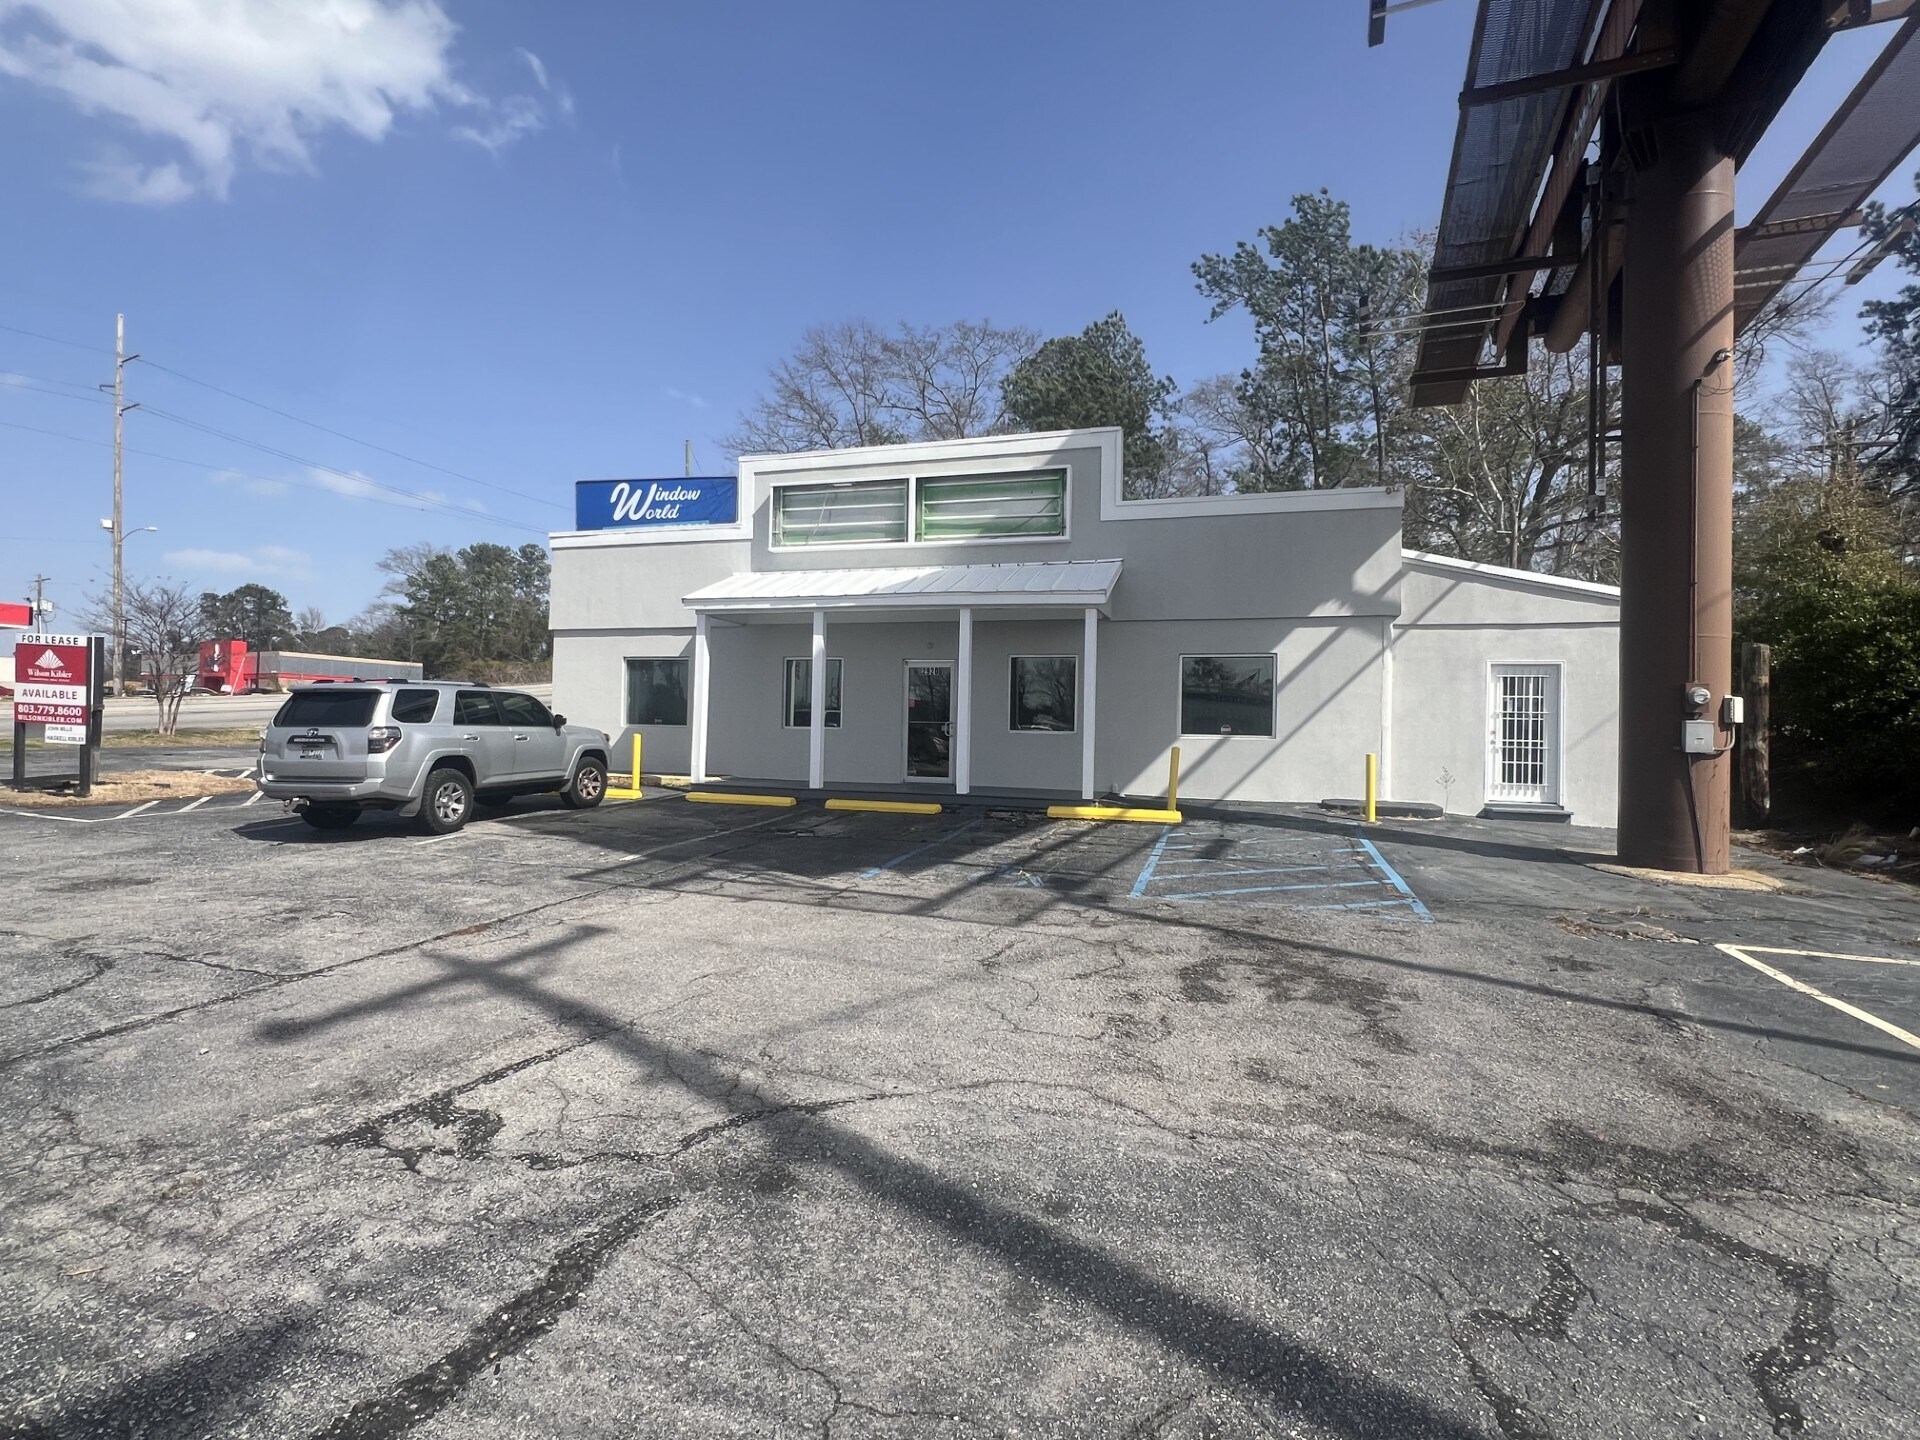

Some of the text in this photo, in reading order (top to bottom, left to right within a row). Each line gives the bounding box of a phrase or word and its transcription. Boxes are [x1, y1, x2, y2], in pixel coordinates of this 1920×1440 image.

[610, 482, 700, 521] Window
[22, 634, 79, 646] FOR LEASE
[27, 668, 72, 678] Wilson Kibler
[22, 688, 78, 700] AVAILABLE
[17, 704, 82, 716] 803.779.8600
[17, 714, 83, 724] WILSONKIBLER.COM
